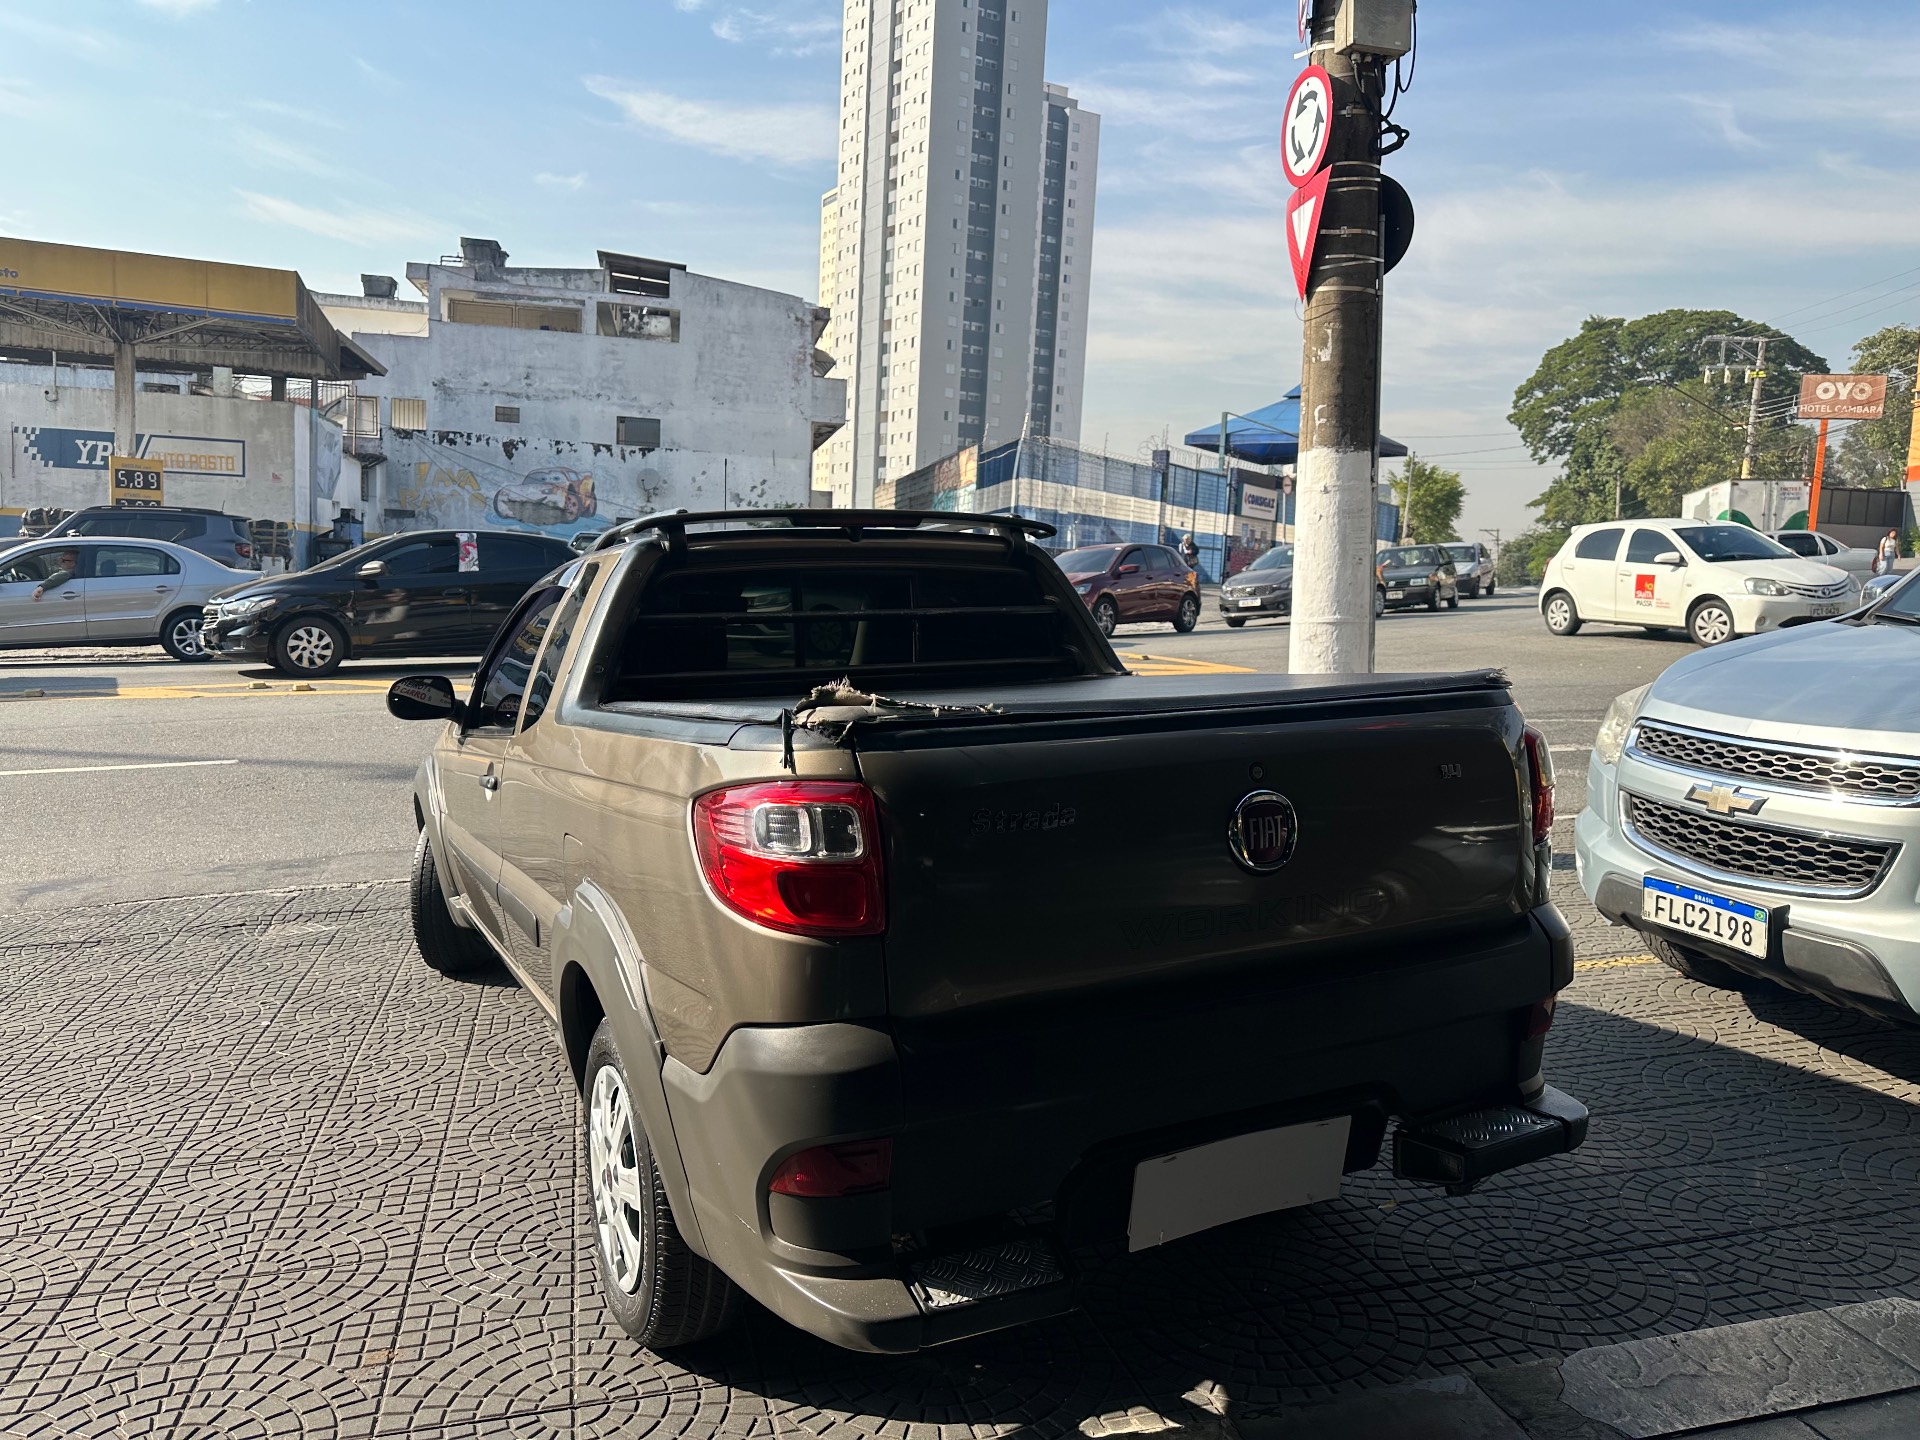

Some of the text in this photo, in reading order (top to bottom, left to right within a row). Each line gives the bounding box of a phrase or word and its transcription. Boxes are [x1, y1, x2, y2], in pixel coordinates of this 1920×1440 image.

[1815, 381, 1873, 401] OYO
[1800, 404, 1883, 414] HOTEL CAMBARA
[189, 453, 235, 472] POSTO
[118, 470, 158, 489] 5,89
[969, 802, 1077, 835] Strada
[1249, 815, 1283, 850] FIAT
[1694, 894, 1715, 905] BRASIL
[1119, 888, 1382, 950] WORKING
[1654, 894, 1753, 947] FLC2I98
